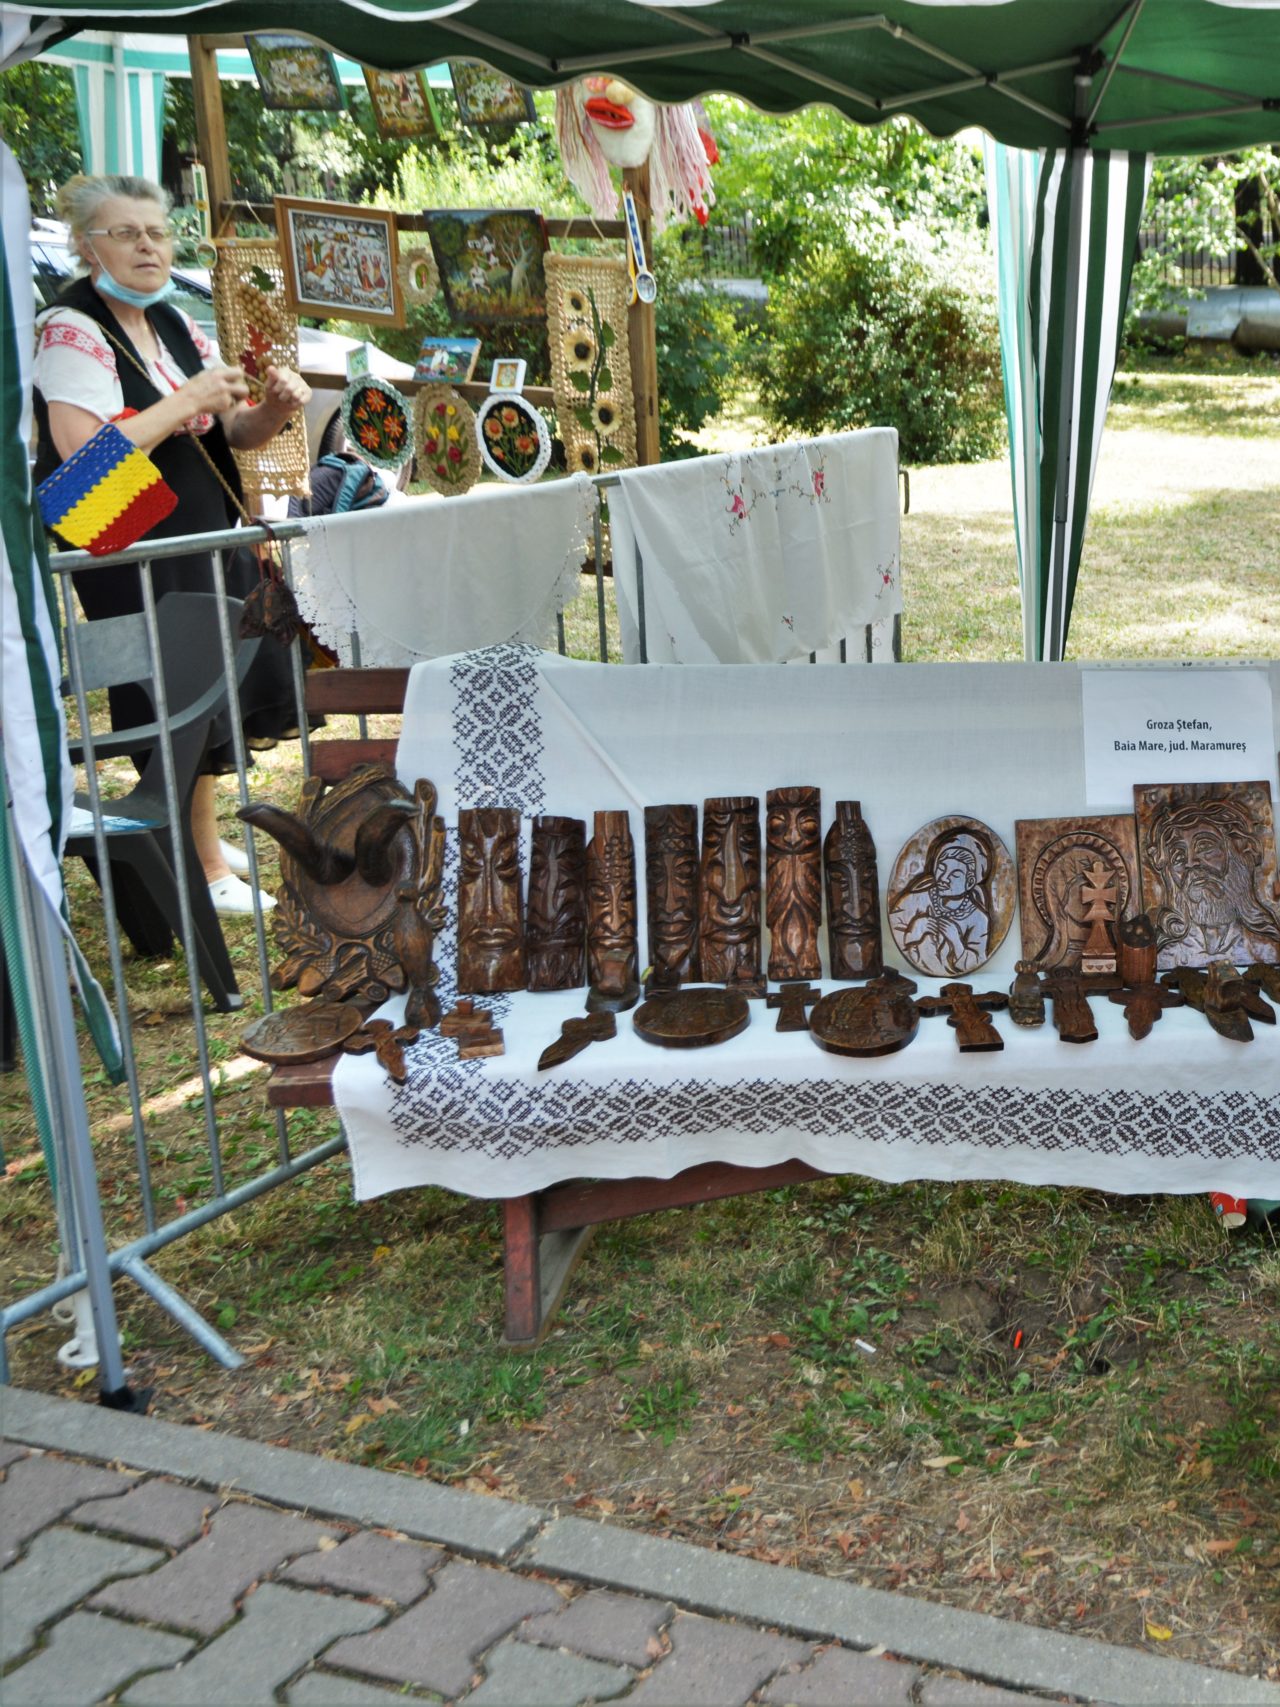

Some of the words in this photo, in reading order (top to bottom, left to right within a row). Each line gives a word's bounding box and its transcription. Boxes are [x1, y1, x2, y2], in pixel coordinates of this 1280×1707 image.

[1146, 719, 1174, 730] Groza
[1114, 740, 1136, 751] Baia
[1138, 740, 1167, 752] Mare,
[1168, 740, 1188, 752] jud.
[1191, 740, 1247, 753] Maramureș
